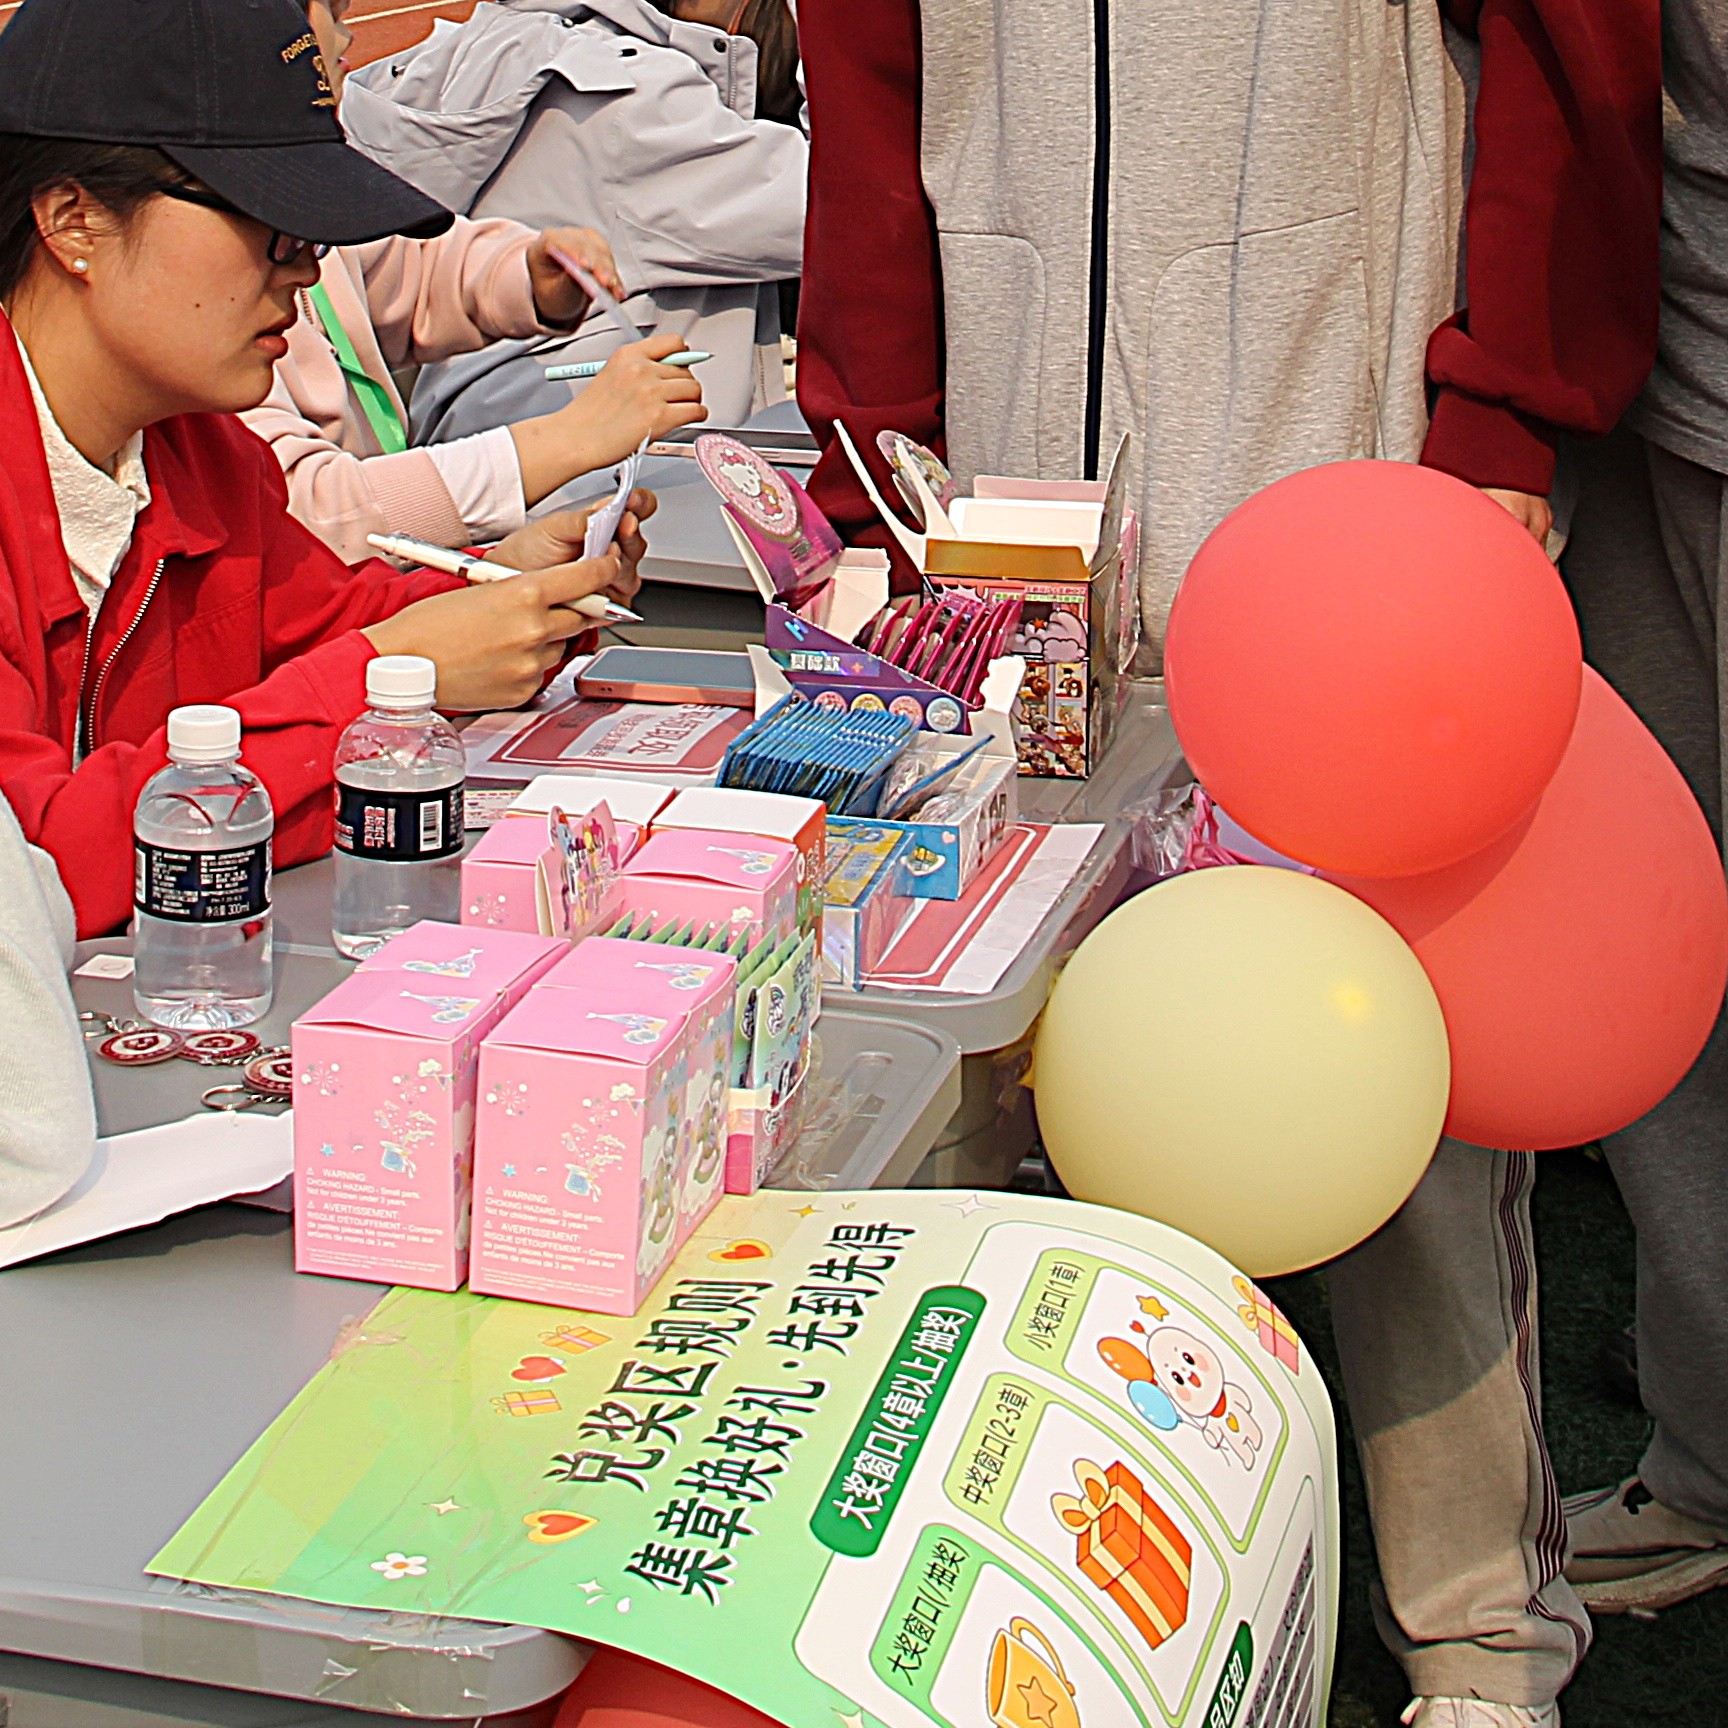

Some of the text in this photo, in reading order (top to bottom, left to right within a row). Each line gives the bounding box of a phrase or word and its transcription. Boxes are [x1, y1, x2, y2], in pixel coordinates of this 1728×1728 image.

[227, 901, 250, 916] 300ml
[1018, 1257, 1089, 1352] 小奖窗口(1章)
[546, 1278, 776, 1490] 兑奖区规则
[622, 1219, 918, 1608] 集章换好礼·先到先得
[830, 1304, 974, 1531] 大奖窗口(4章以上/抽奖)
[956, 1381, 1033, 1508] 中奖窗口(2-3章)
[887, 1536, 971, 1689] 大奖窗口(/抽奖)
